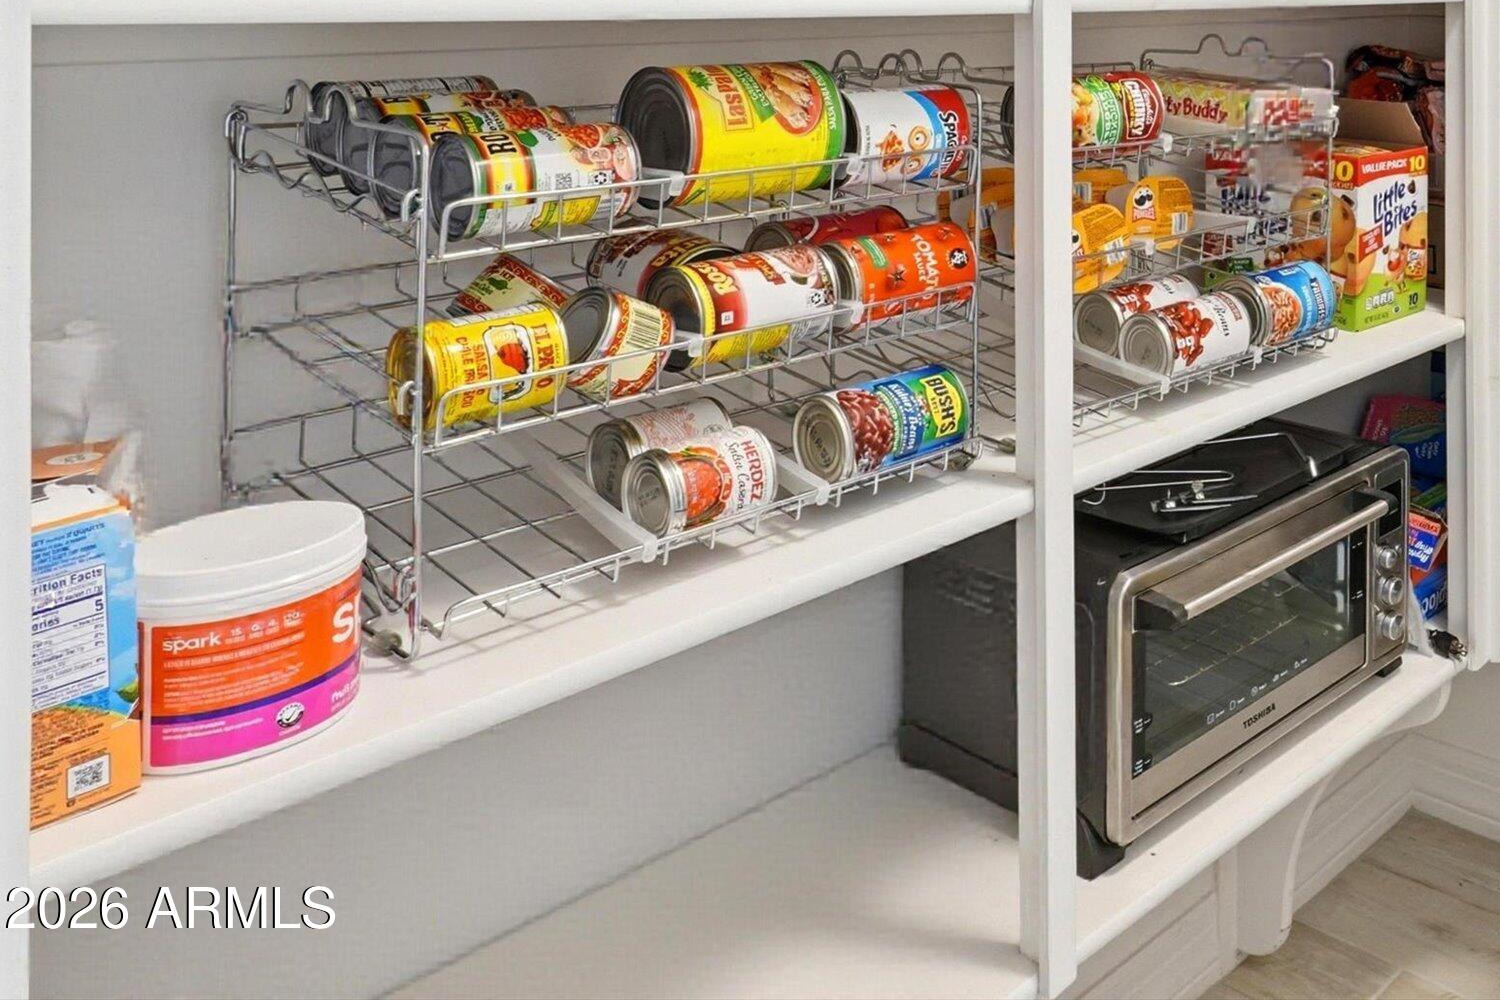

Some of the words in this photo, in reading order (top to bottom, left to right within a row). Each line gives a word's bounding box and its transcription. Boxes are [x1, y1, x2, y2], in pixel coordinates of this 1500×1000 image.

[1124, 80, 1145, 135] CHUNKY
[1183, 97, 1228, 124] Buddy
[1362, 161, 1386, 174] VALUE
[1386, 159, 1408, 171] PACK
[1408, 155, 1426, 172] 10
[1373, 182, 1406, 223] Little
[1384, 200, 1418, 237] Bites
[1408, 292, 1419, 305] 10
[472, 344, 489, 380] SALSA
[890, 383, 914, 413] Kidney
[925, 377, 956, 434] BUSH'S
[907, 416, 919, 450] Beans
[725, 441, 741, 470] Salsa
[740, 440, 765, 501] HERDEZ
[736, 472, 750, 510] Casera
[32, 578, 67, 596] rition
[70, 567, 104, 586] Facts
[95, 598, 104, 612] 5
[162, 632, 222, 656] spark
[1242, 703, 1277, 730] TOSHIBA
